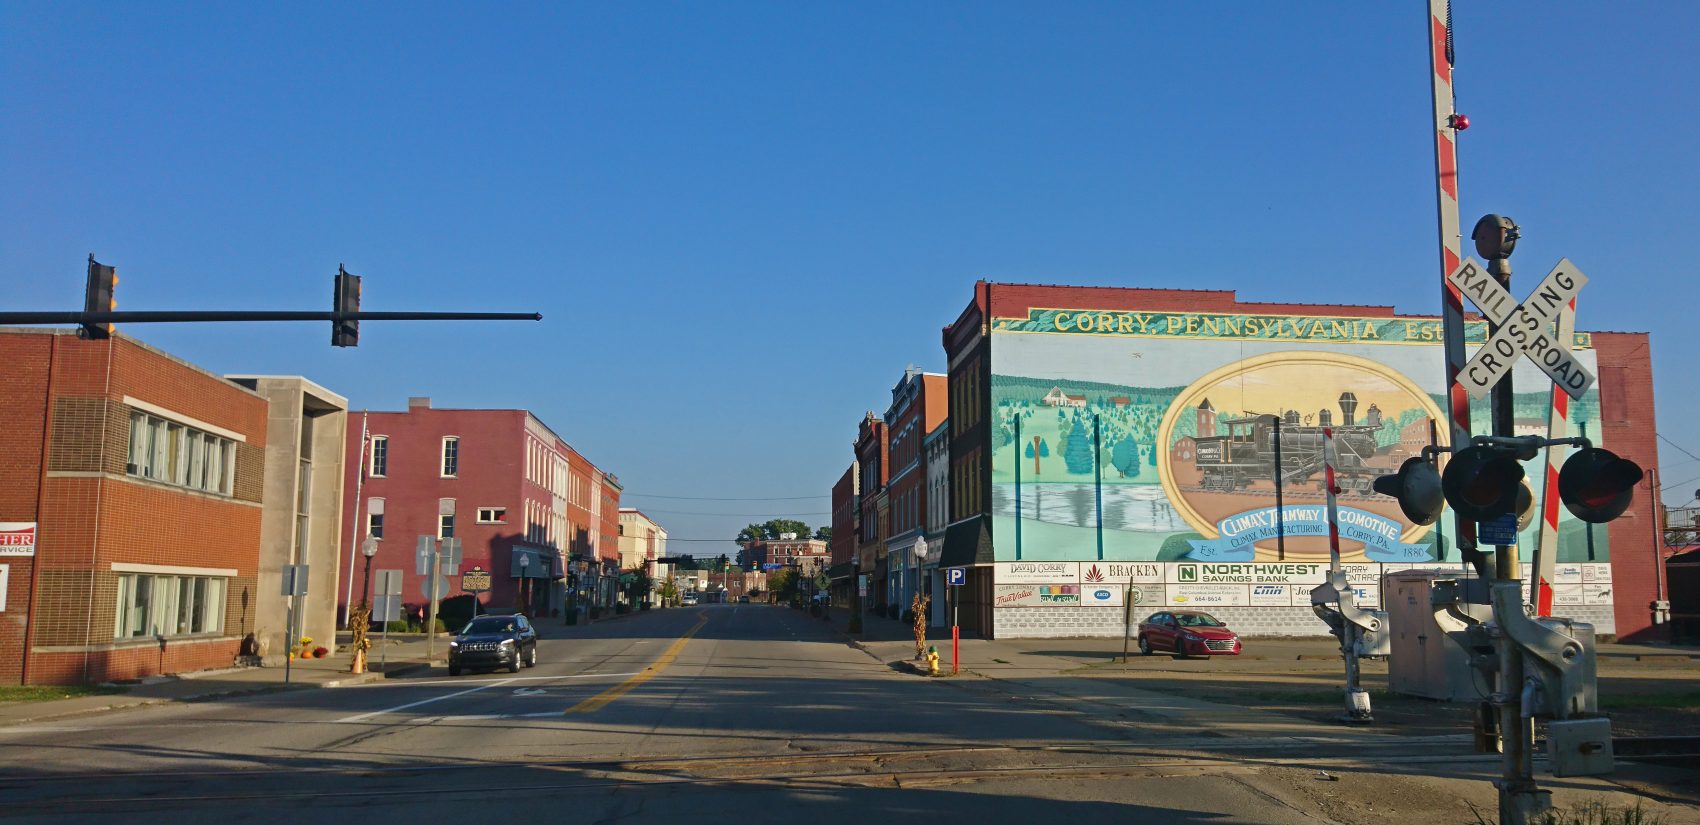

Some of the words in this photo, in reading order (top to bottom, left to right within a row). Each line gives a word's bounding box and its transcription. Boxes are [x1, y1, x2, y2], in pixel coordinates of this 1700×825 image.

[1054, 312, 1157, 335] CORRY,
[1166, 315, 1380, 339] PENNSYLVANIA
[1456, 262, 1506, 319] RAIL
[1529, 334, 1586, 390] ROAD
[1468, 271, 1575, 387] CROSSING
[1221, 510, 1268, 537] CLIMAX
[1323, 506, 1398, 541] LCOMOTIVE
[1230, 531, 1257, 548] CLIMAX
[1403, 547, 1425, 558] 1880
[1011, 564, 1036, 573] DAVID
[1038, 564, 1066, 573] CORRY
[1108, 564, 1159, 577] BRACKEN
[1202, 564, 1320, 575] NORTHWEST
[1339, 565, 1368, 574] ORRY
[951, 569, 962, 583] P
[1202, 575, 1253, 583] SAVINGS
[1256, 575, 1290, 583] BANK
